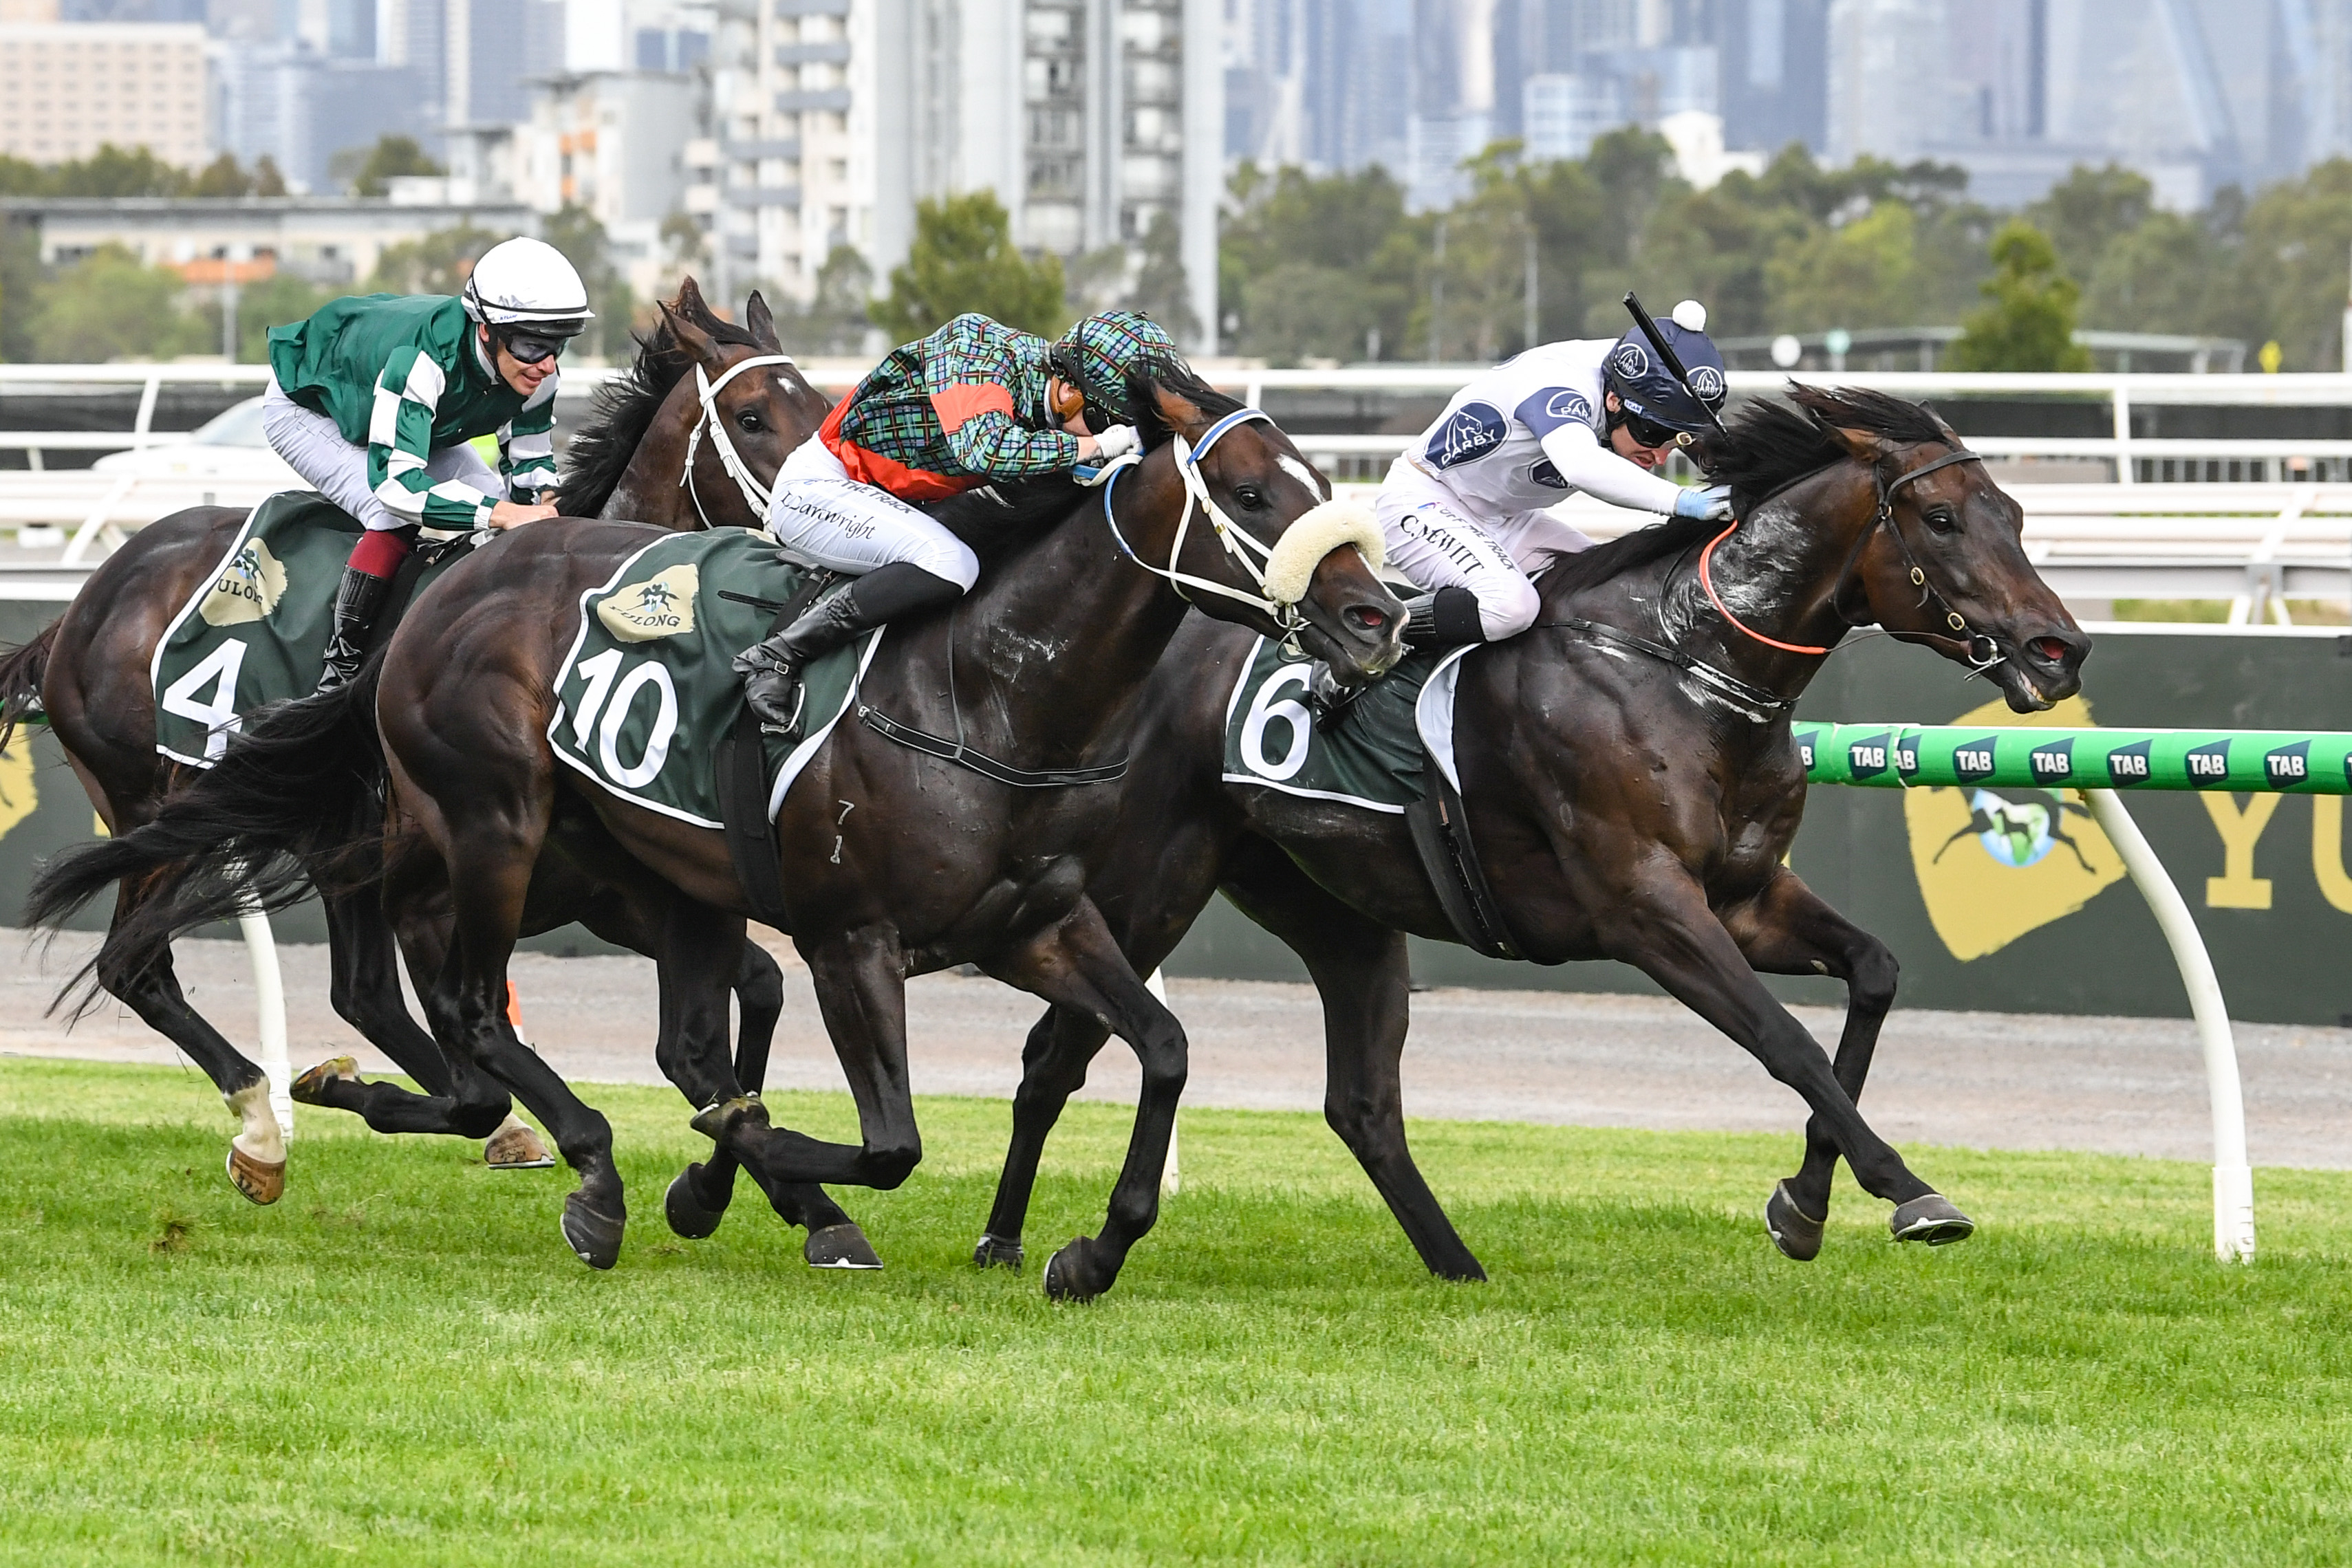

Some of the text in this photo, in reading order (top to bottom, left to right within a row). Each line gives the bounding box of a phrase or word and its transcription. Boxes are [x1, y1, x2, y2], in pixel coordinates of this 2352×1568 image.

[1560, 406, 1591, 421] DAR
[1441, 429, 1498, 466] DARBY
[841, 480, 919, 514] THE TRACK
[1483, 541, 1520, 573] TRACK
[609, 605, 680, 627] YULONG
[162, 638, 248, 761] 4
[572, 647, 678, 788] 10
[1240, 663, 1313, 781] 6
[1851, 745, 2306, 776] TAB AB TAB TAB TAB TAB TAB
[838, 799, 855, 825] 7
